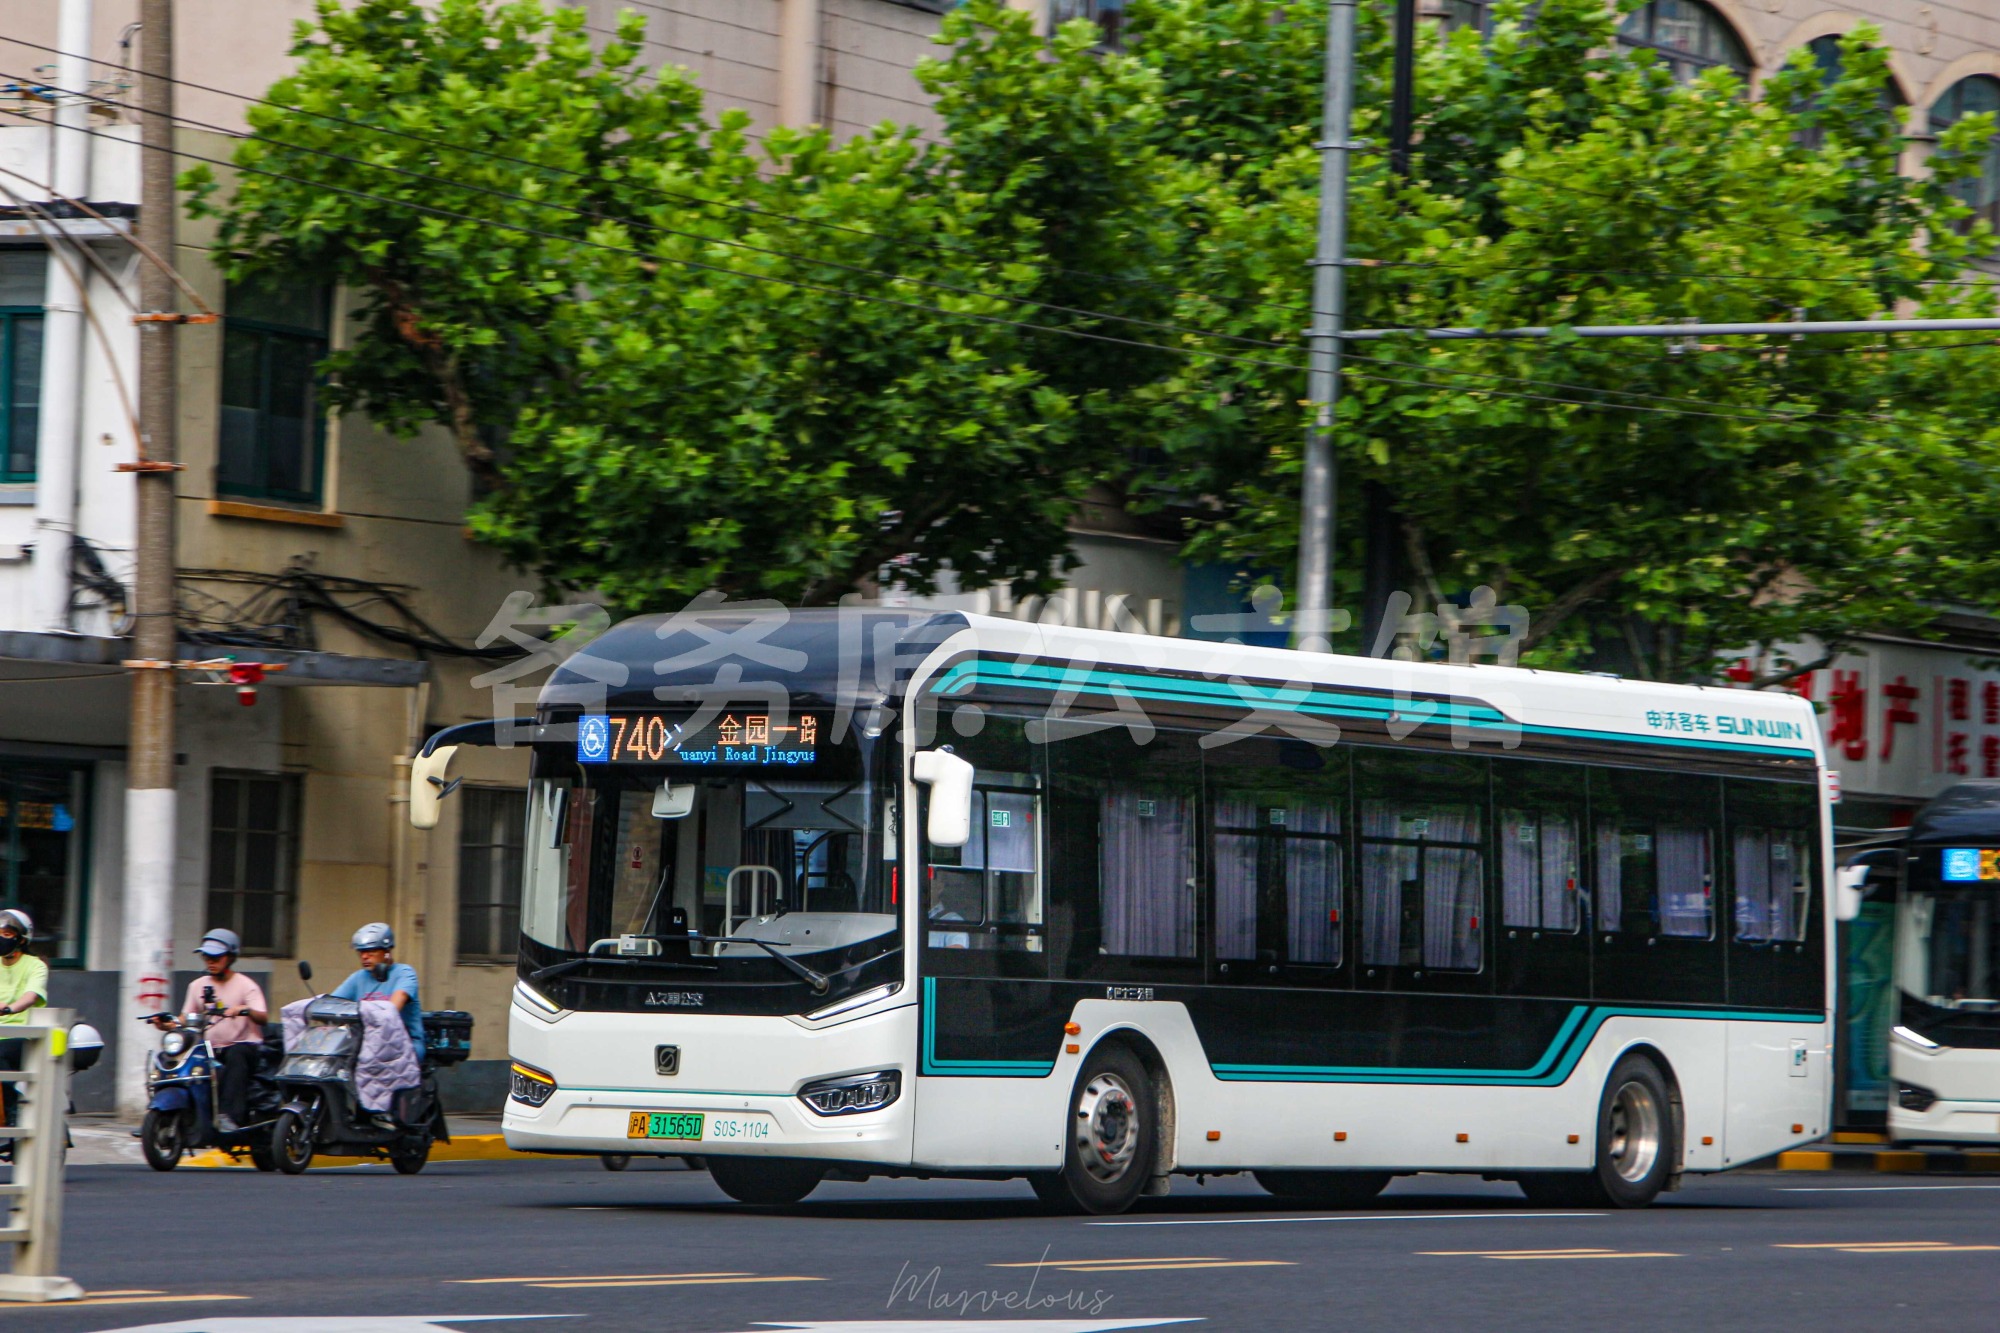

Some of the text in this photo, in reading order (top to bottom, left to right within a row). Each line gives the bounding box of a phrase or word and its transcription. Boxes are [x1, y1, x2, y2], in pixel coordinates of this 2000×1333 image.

[609, 714, 817, 760] 740 金园一路
[1716, 715, 1803, 740] SUNWIN
[725, 746, 757, 761] Road
